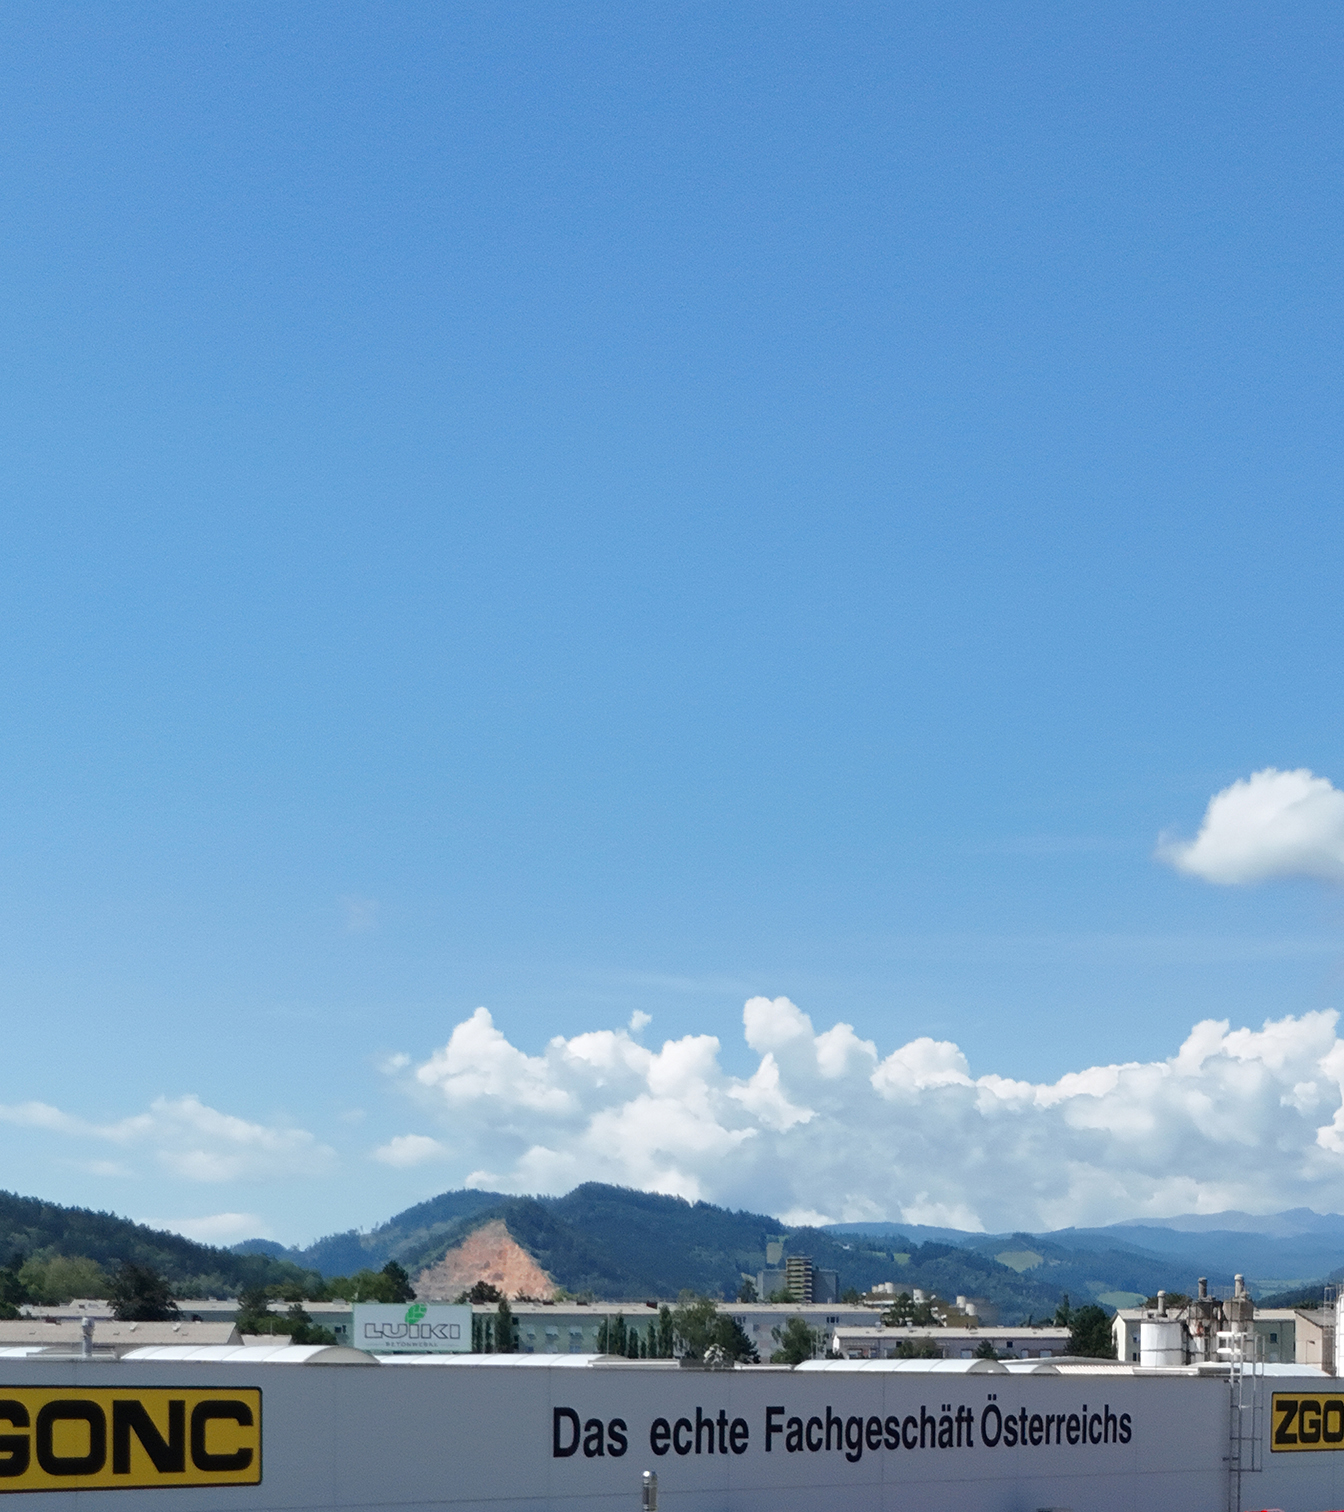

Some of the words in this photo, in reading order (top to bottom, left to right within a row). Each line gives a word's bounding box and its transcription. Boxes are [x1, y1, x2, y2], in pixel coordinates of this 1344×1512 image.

[364, 1323, 461, 1339] LUIKI
[553, 1407, 628, 1458] Das
[650, 1408, 749, 1455] echte
[765, 1403, 974, 1462] Fachgeschäft
[981, 1394, 1132, 1447] Österreichs
